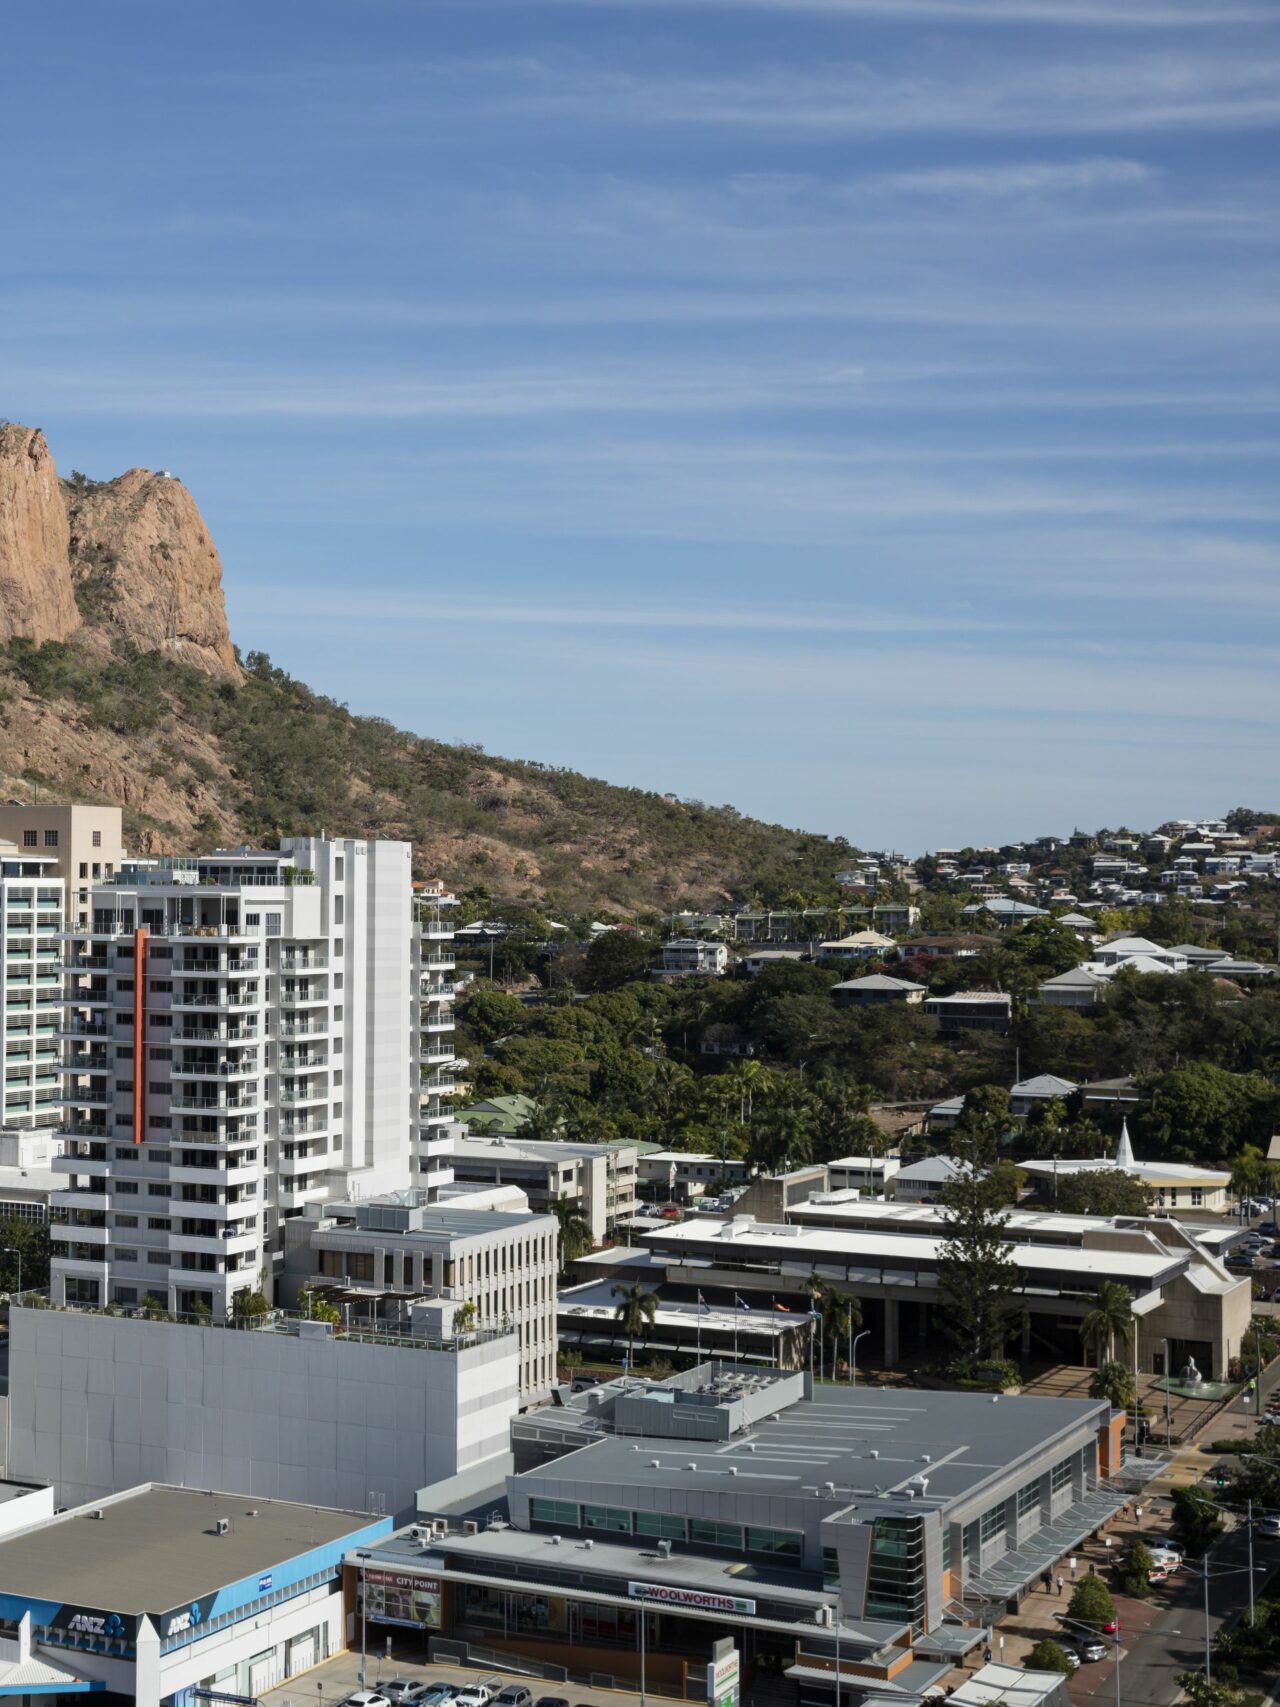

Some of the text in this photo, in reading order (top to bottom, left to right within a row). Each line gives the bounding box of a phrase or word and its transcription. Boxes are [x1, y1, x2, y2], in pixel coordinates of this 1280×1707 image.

[396, 1577, 413, 1586] CITY
[414, 1581, 438, 1590] POINT
[648, 1587, 734, 1610] WOOLWORTHS
[68, 1614, 105, 1634] ANZ
[167, 1612, 190, 1635] ANZ
